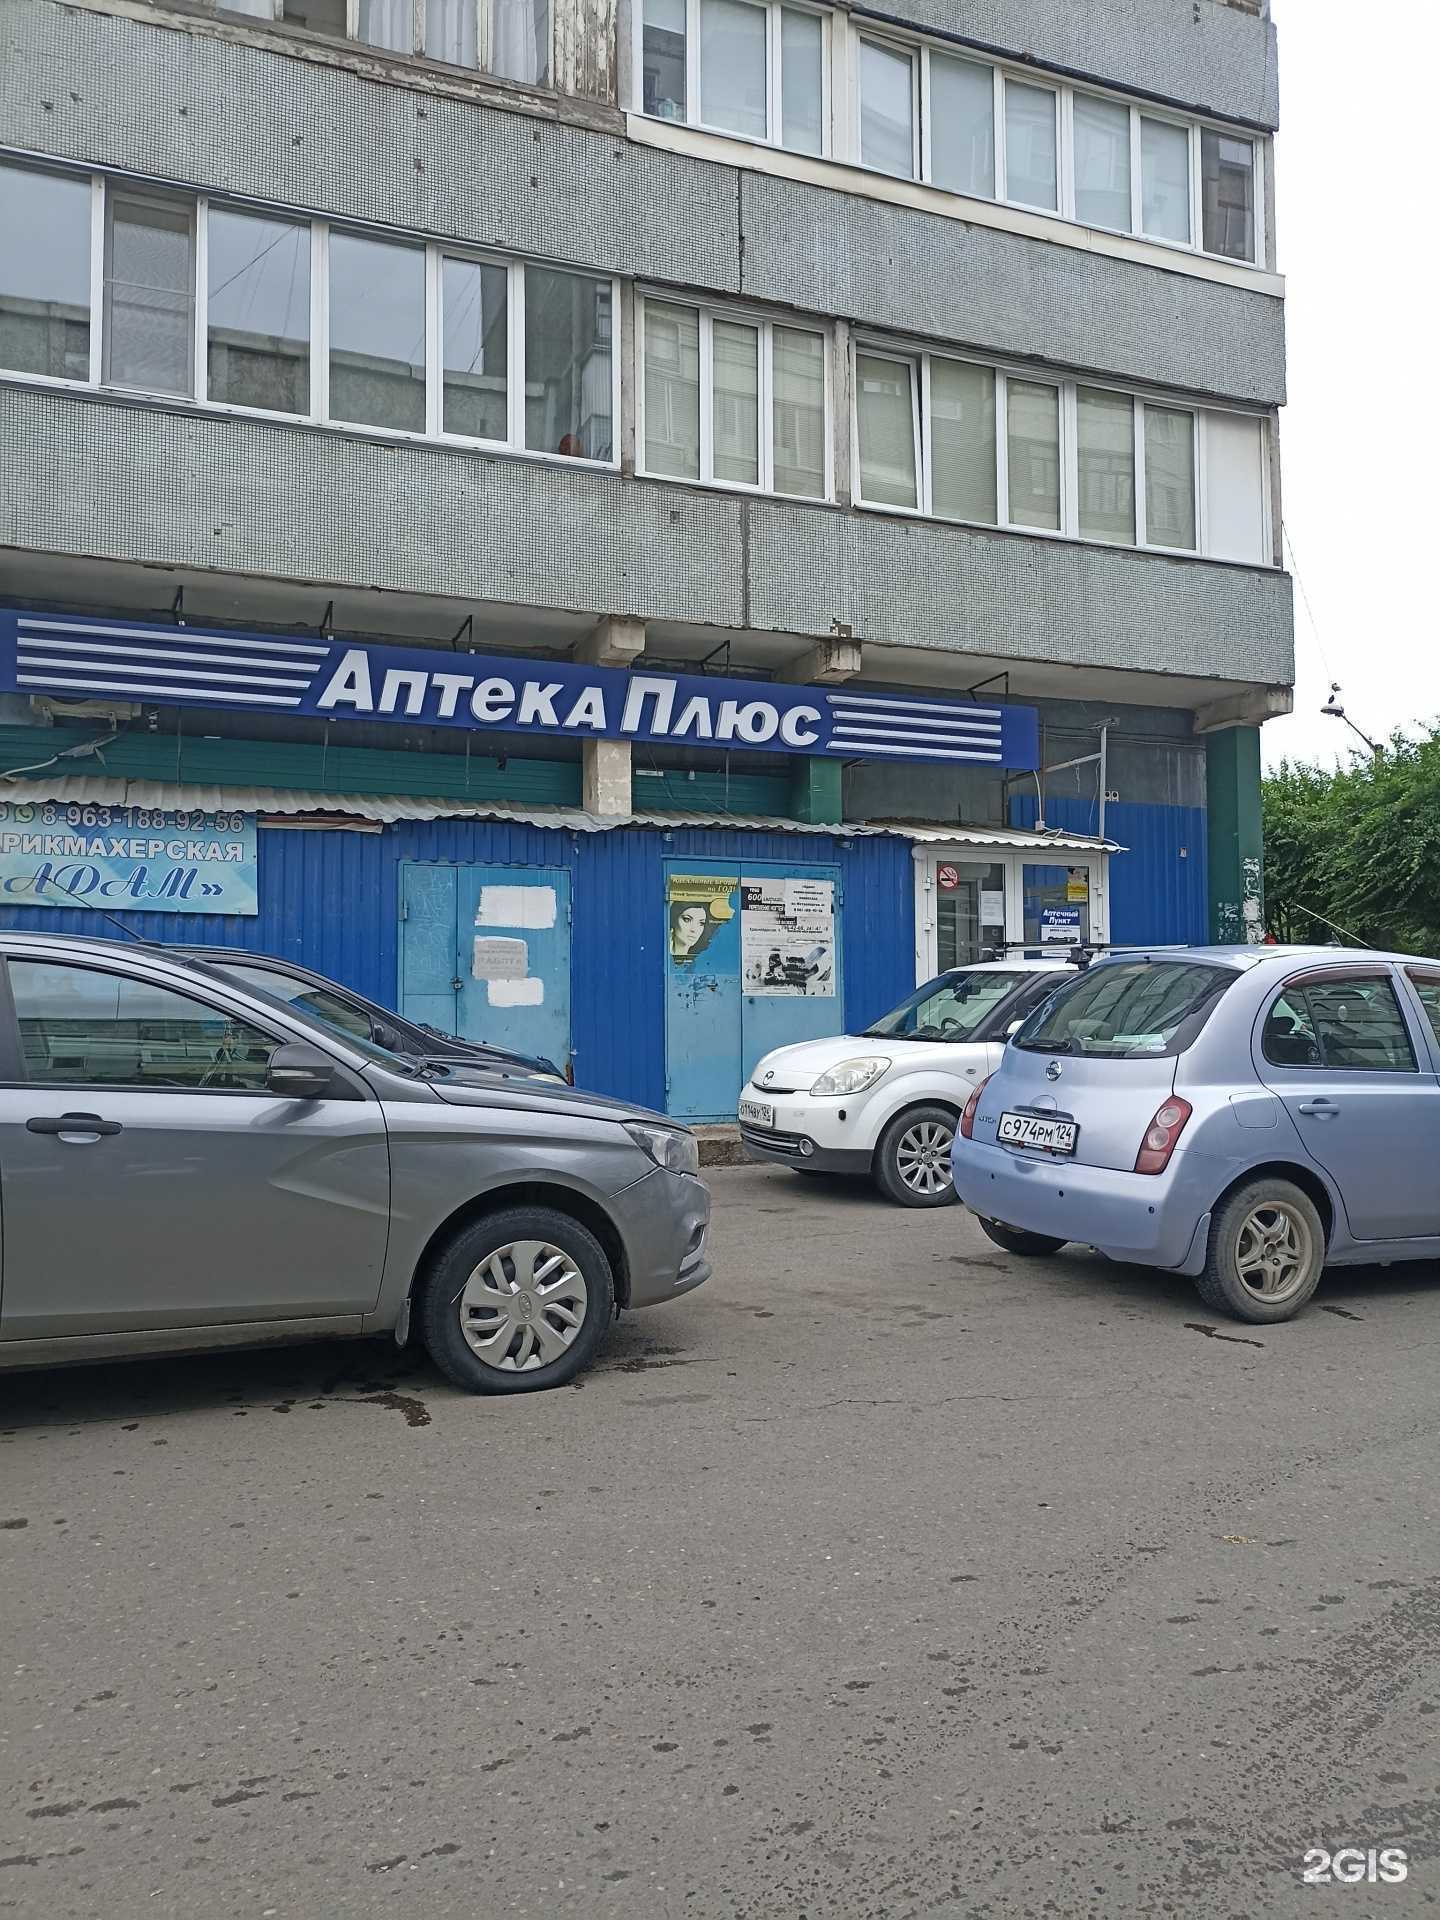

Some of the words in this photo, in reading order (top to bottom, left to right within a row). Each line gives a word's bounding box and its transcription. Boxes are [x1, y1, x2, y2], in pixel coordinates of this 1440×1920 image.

[620, 676, 822, 747] Плюс
[41, 804, 245, 833] 8-963-188-92-56
[0, 832, 244, 862] РИКМАХЕРСКАЯ
[0, 862, 224, 900] АДАМ»
[1043, 909, 1079, 918] Аптечный
[1049, 916, 1072, 926] Пункт
[1003, 1119, 1054, 1143] С974РМ
[1056, 1124, 1072, 1140] 124
